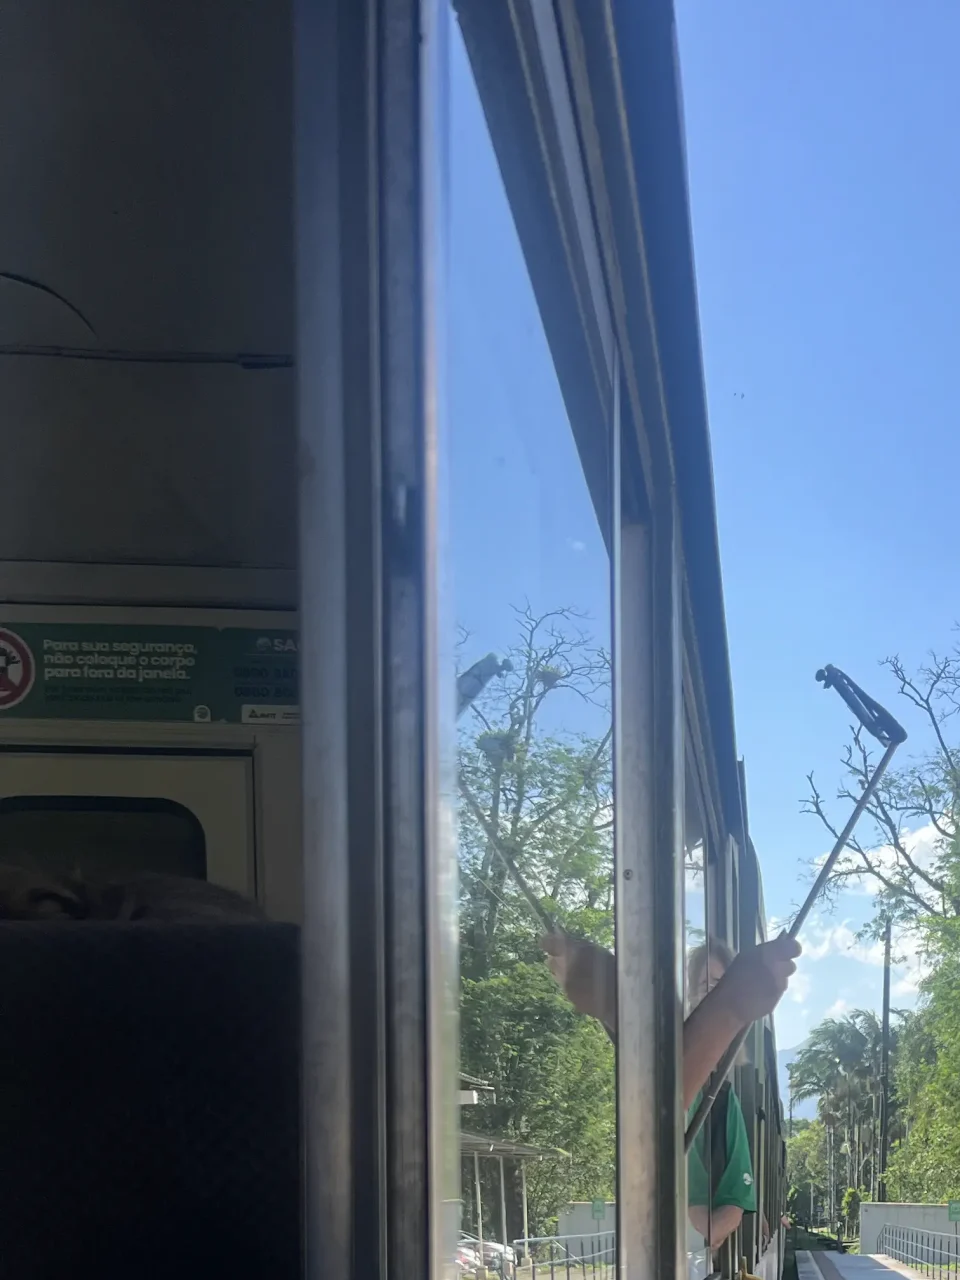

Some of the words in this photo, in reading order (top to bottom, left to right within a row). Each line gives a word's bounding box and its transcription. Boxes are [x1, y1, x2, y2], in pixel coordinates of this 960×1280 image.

[43, 639, 79, 651] Para
[81, 641, 109, 651] sua
[112, 641, 197, 656] segurança,
[43, 652, 74, 664] não
[76, 653, 137, 668] coloque
[139, 656, 149, 665] o
[150, 656, 195, 669] corpo
[44, 667, 81, 680] para
[83, 666, 114, 678] fora
[116, 666, 137, 678] da
[138, 666, 191, 682] janela.
